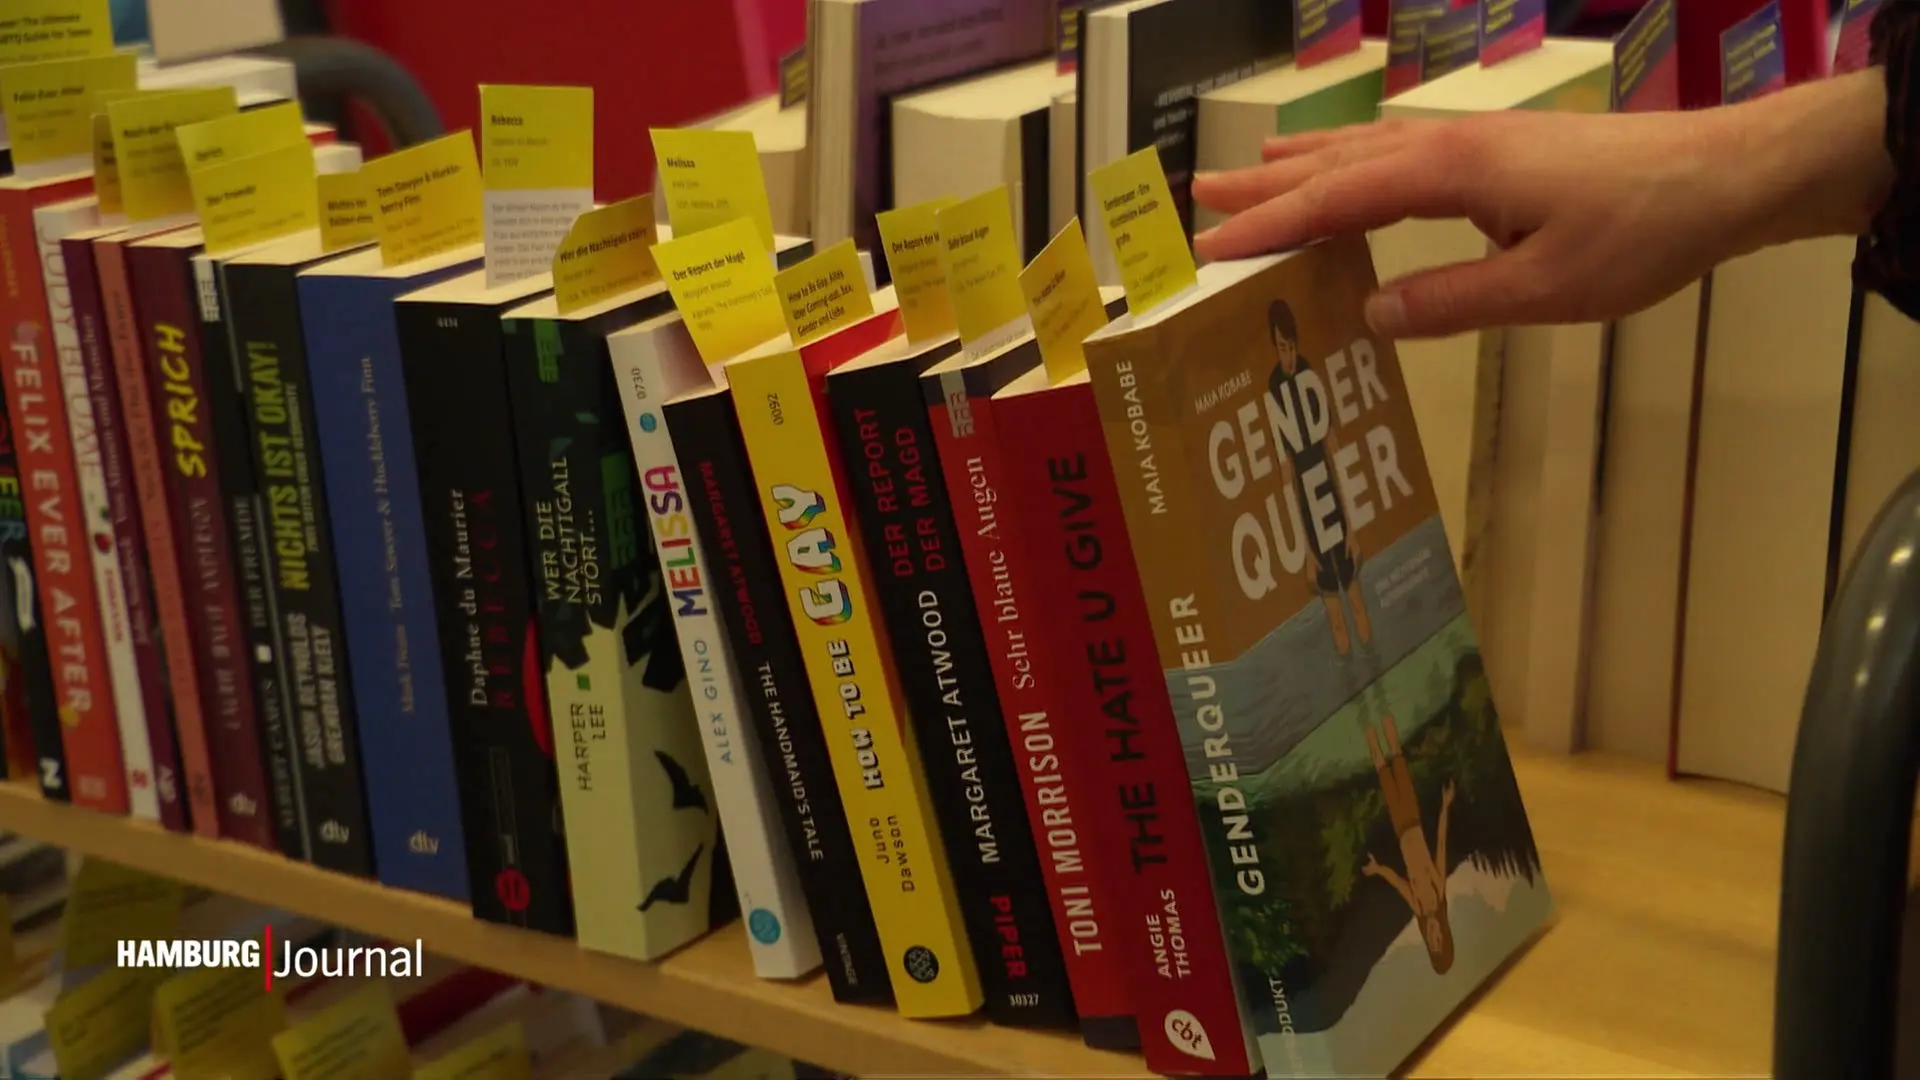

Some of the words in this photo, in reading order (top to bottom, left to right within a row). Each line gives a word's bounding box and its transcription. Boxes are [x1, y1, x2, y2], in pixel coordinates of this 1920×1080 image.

[491, 115, 523, 127] Rebecca
[666, 158, 696, 169] Melissa
[672, 270, 687, 282] Der
[687, 262, 713, 278] Report
[725, 249, 746, 267] Magd
[11, 342, 54, 454] FELIX
[154, 321, 208, 479] SPRICH
[245, 340, 287, 425] OKAY!
[360, 355, 376, 393] Finn
[766, 393, 785, 427] 0092
[1116, 359, 1153, 456] KOBABE
[1194, 392, 1220, 416] MAIA
[1218, 369, 1253, 400] KOBABE
[258, 431, 293, 478] IST
[366, 398, 388, 494] Huckleberry
[1208, 337, 1390, 502] GENDER
[853, 406, 900, 515] REPORT
[894, 425, 933, 509] MAGD
[965, 456, 1002, 542] Augen
[1140, 459, 1169, 516] MAIA
[32, 469, 73, 577] EVER
[234, 496, 262, 582] FREMDE
[268, 483, 311, 592] NICHTS
[381, 518, 398, 573] Sawyer
[451, 487, 474, 581] Maurier
[535, 500, 555, 541] DIE
[551, 457, 582, 603] NACHTIGALL
[645, 465, 708, 618] MELISSA
[882, 523, 915, 579] DER
[915, 516, 947, 573] DER
[1047, 452, 1103, 571] GIVE
[1231, 424, 1414, 602] QUEER
[541, 550, 562, 602] WER
[698, 461, 740, 562] MARGARET
[729, 562, 764, 646] ATWOOD
[771, 482, 853, 627] GAY
[988, 548, 1019, 625] blaue
[246, 587, 266, 628] DER
[458, 588, 479, 616] du
[1078, 590, 1116, 623] U
[51, 585, 93, 713] AFTER
[285, 612, 318, 707] REYNOLDS
[464, 622, 488, 707] Daphne
[693, 640, 719, 701] GINO
[827, 640, 856, 679] BE
[917, 589, 964, 707] ATWOOD
[1003, 630, 1036, 692] Sehr
[589, 705, 607, 741] LEE
[708, 711, 733, 765] ALEX
[840, 679, 867, 720] TO
[1087, 638, 1145, 765] HATE
[571, 704, 594, 792] HARPER
[757, 661, 776, 699] THE
[767, 699, 812, 816] HANDMAID'S
[798, 815, 825, 862] TALE
[850, 726, 885, 791] HOW
[1168, 593, 1267, 897] GENDERQUEER
[947, 716, 1000, 865] MARGARET
[1018, 710, 1084, 875] MORRISON
[1119, 781, 1168, 876] THE
[320, 819, 350, 844] dtv
[408, 830, 440, 854] dtv
[869, 818, 890, 866] Juno
[886, 814, 915, 893] Dawson
[835, 932, 858, 987] VINTAGE
[989, 893, 1027, 980] PIPER
[1061, 886, 1103, 957] TONI
[1145, 913, 1173, 980] ANGIE
[1161, 888, 1192, 980] THOMAS
[1007, 992, 1040, 1008] 30327
[1171, 1018, 1204, 1050] cbt
